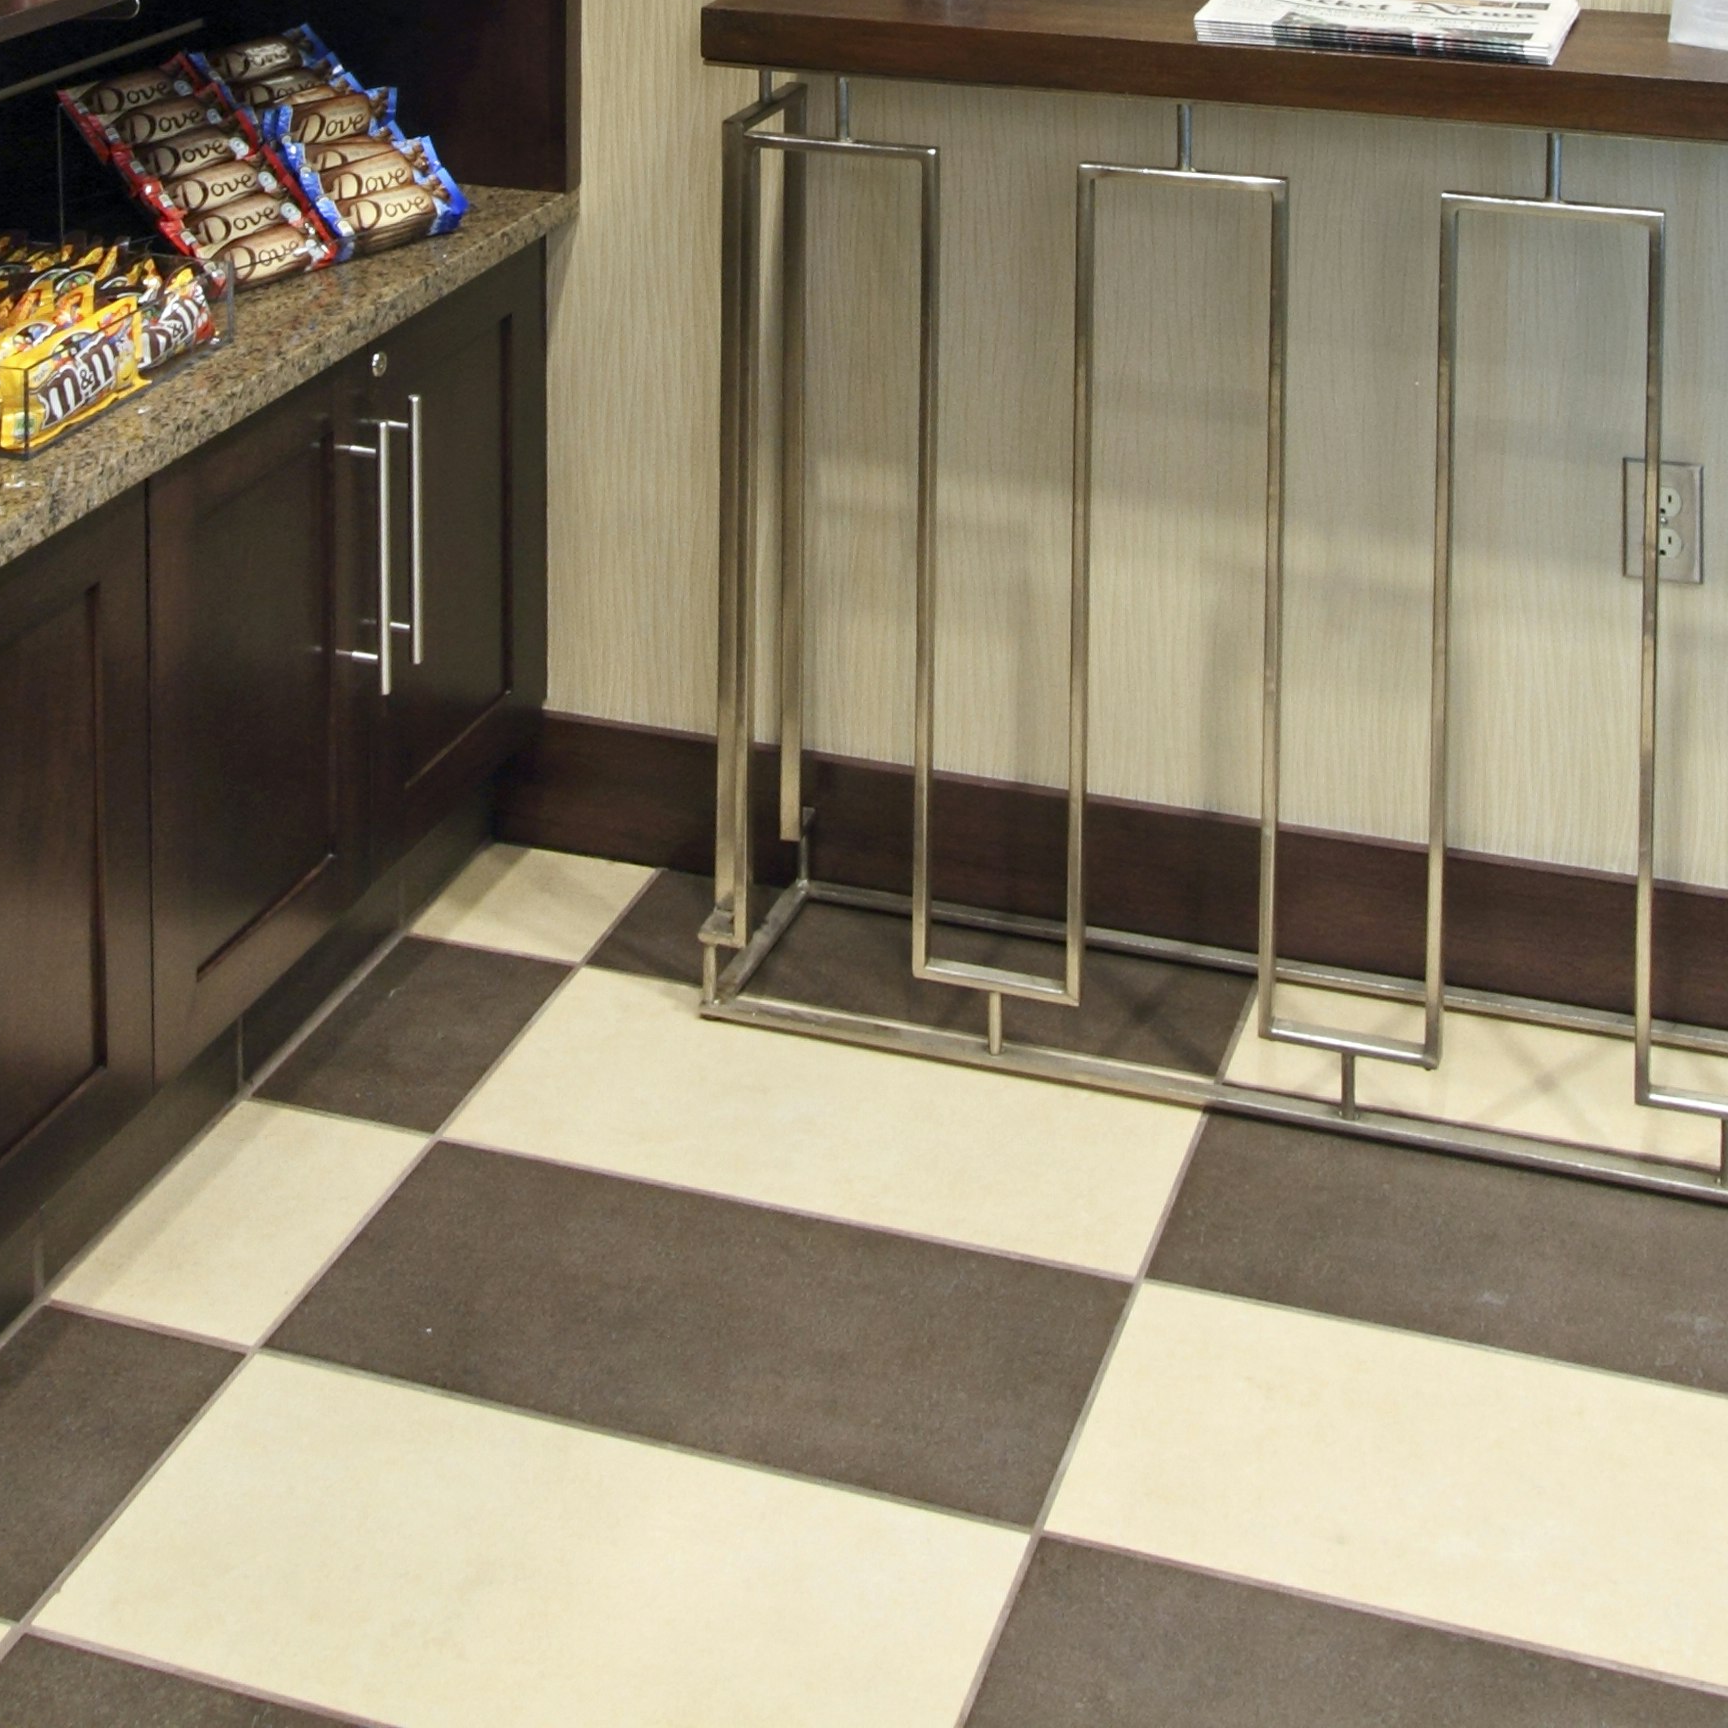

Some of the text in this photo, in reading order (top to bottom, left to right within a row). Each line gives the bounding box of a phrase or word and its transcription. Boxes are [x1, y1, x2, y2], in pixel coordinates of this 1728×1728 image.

[94, 81, 169, 115] Dove
[125, 108, 203, 146] Dove
[298, 112, 367, 145] Dove
[145, 138, 228, 178] Dove
[171, 172, 253, 211] Dove
[332, 165, 409, 201] Dove
[194, 206, 276, 246] Dove
[348, 194, 428, 230] Dove
